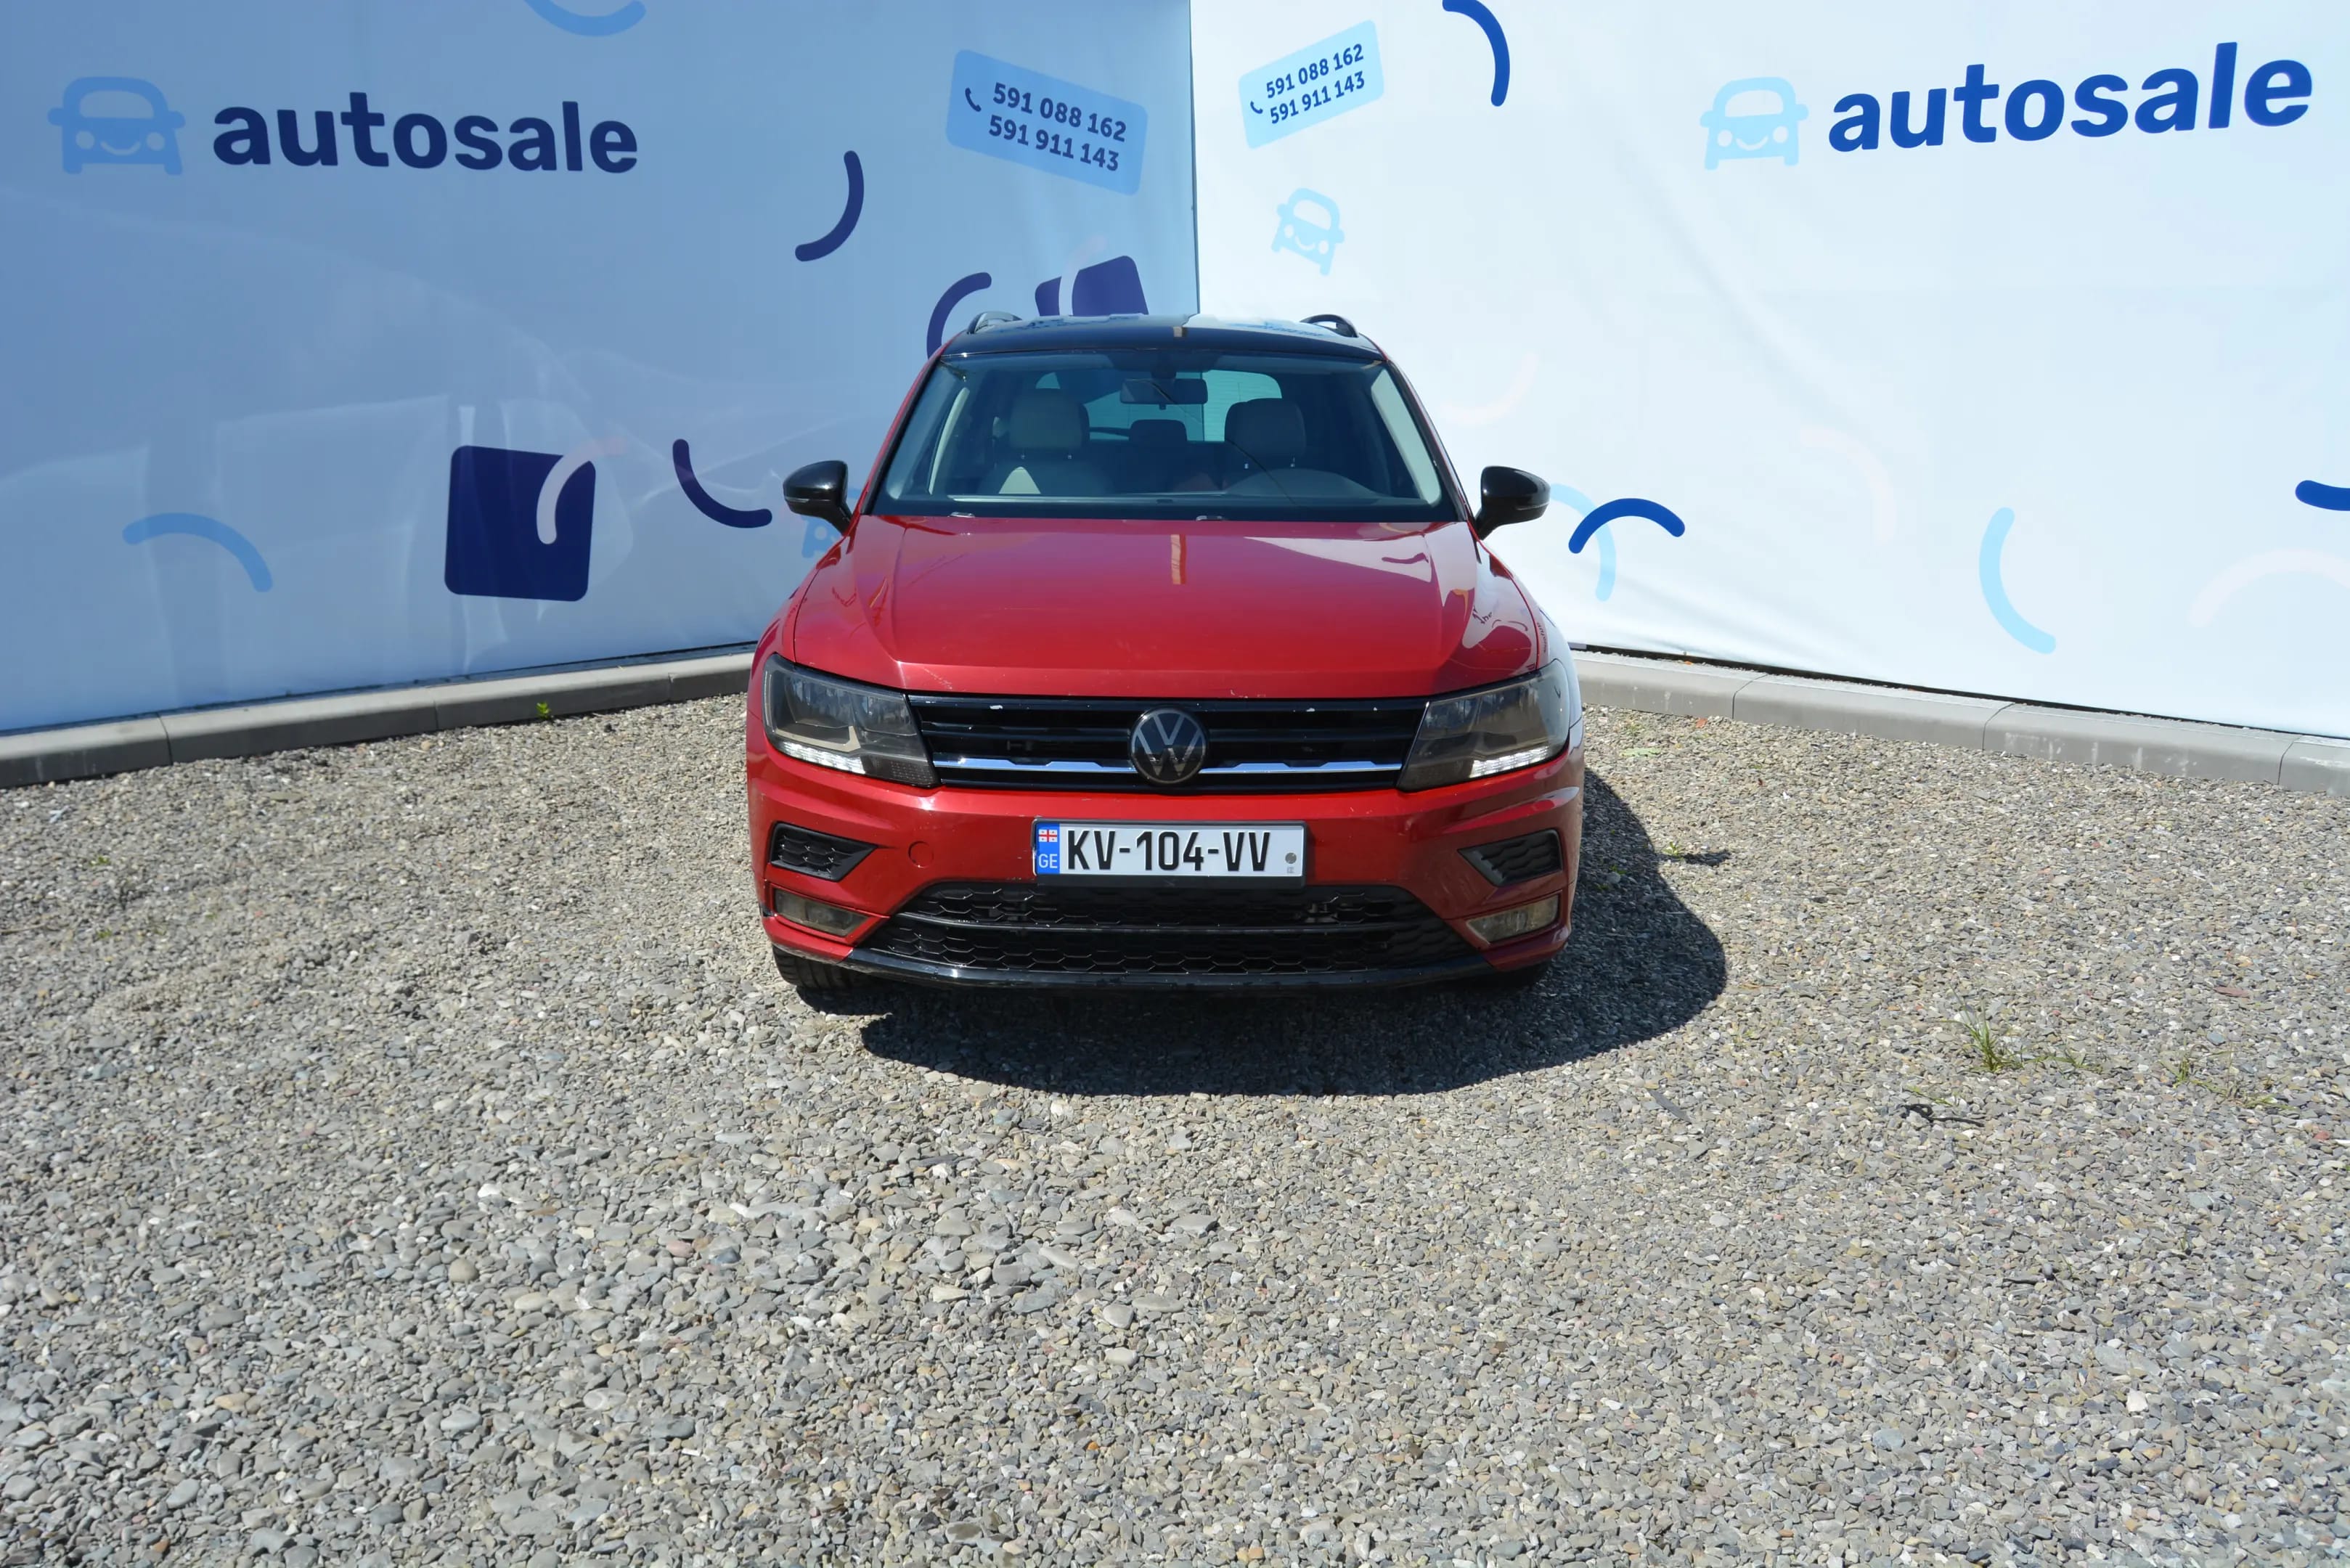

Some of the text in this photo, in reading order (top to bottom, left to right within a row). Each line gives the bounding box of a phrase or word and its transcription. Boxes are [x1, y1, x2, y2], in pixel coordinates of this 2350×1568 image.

[1265, 44, 1364, 99] 591 088 162
[1270, 70, 1365, 124] 591 911 143
[1829, 41, 2313, 152] autosale
[213, 91, 638, 174] autosale
[992, 82, 1127, 142] 591 088 162
[989, 114, 1119, 171] 591 911 143
[1038, 854, 1058, 869] GE
[1068, 830, 1270, 872] KV-104-VV
